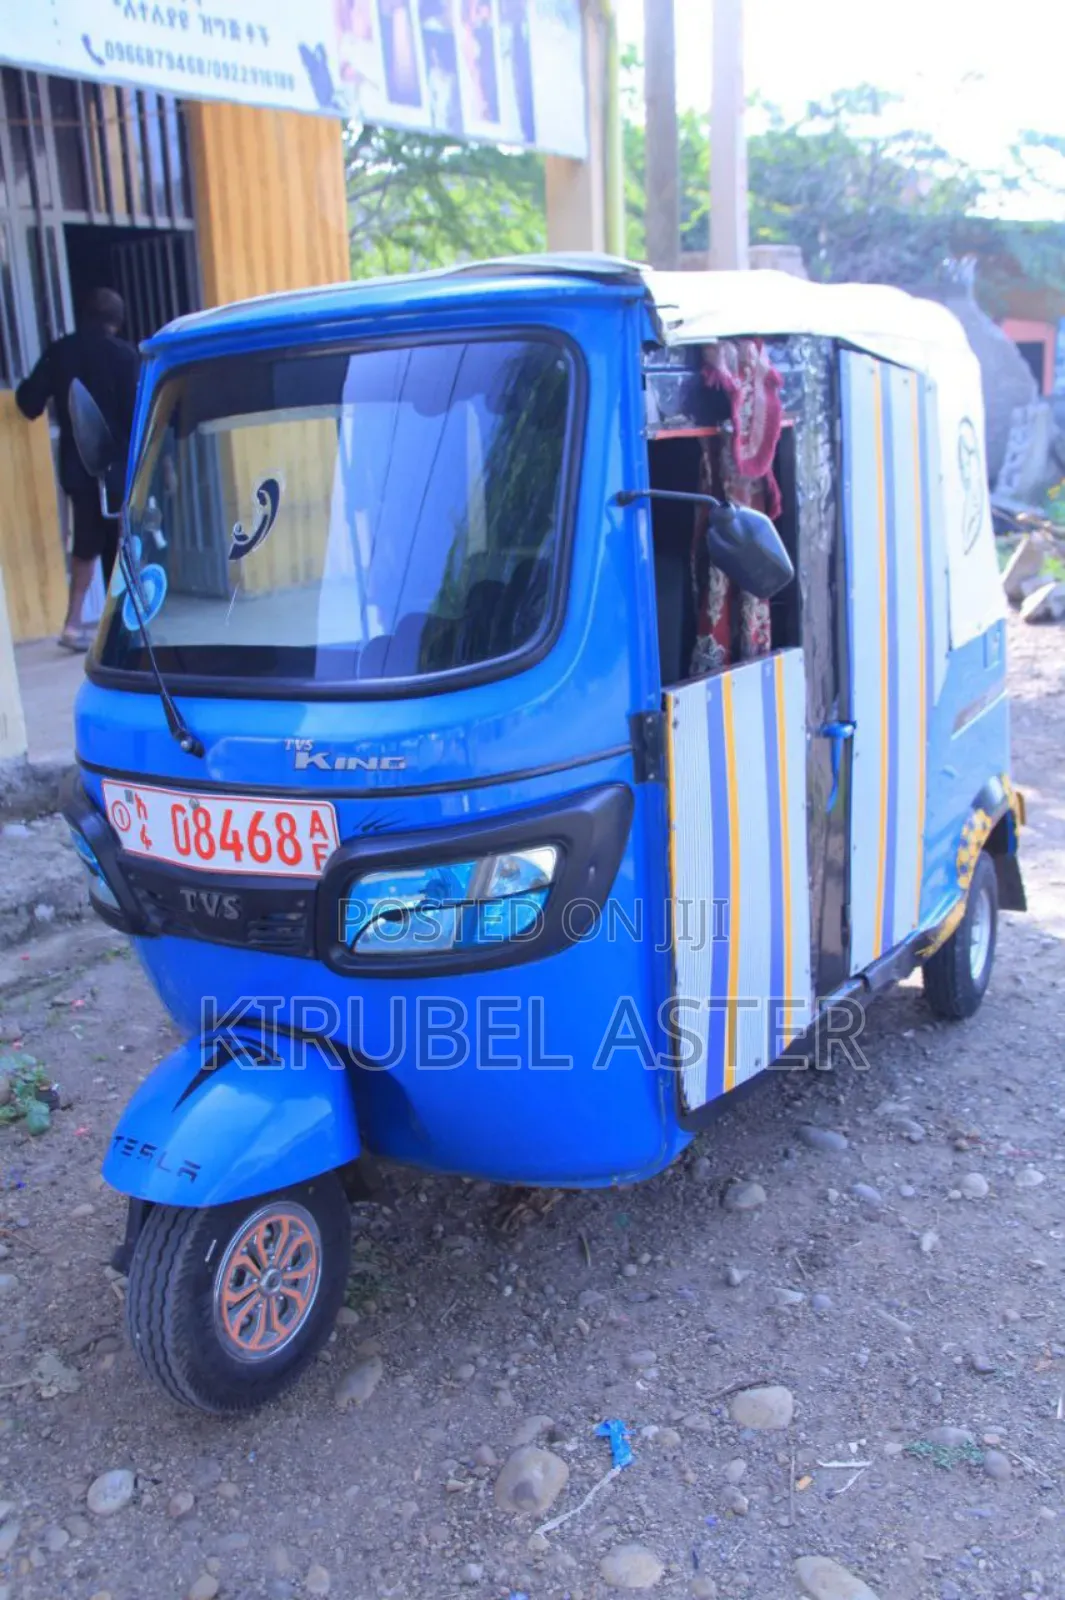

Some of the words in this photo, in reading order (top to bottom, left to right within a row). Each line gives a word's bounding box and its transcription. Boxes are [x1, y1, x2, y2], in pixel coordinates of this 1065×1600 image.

[284, 738, 314, 751] TVS
[171, 803, 303, 867] 08468
[179, 888, 242, 920] TVS
